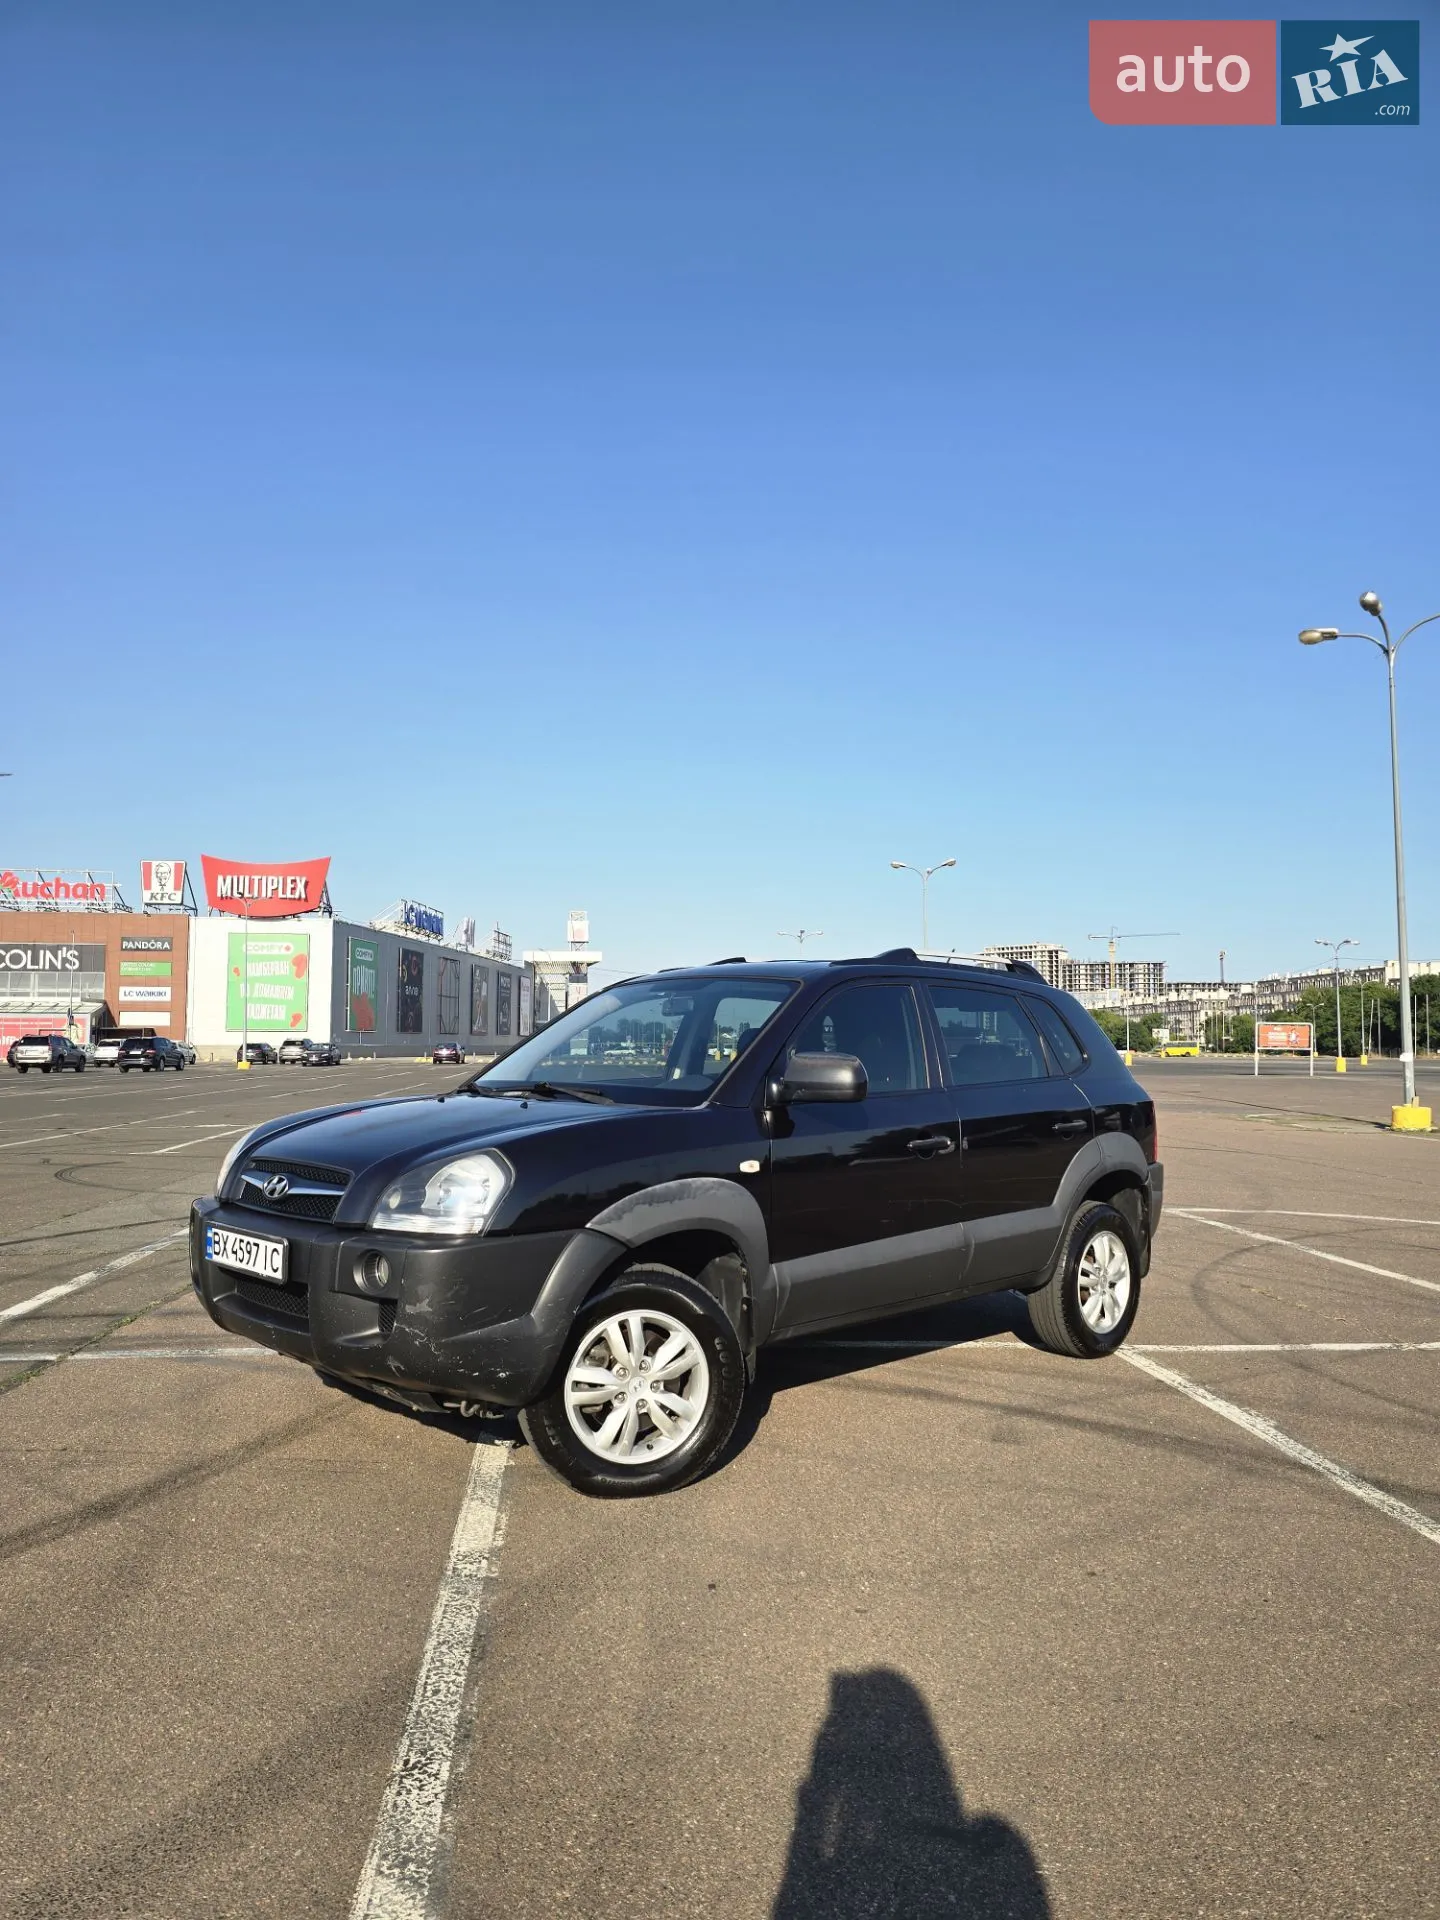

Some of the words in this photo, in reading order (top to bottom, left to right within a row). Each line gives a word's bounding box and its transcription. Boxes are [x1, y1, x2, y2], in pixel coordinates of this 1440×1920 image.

[149, 892, 177, 901] KFC
[217, 874, 307, 900] MULTIPLEX
[213, 1231, 229, 1259] BX
[231, 1237, 260, 1268] 4597
[264, 1245, 280, 1273] IC
